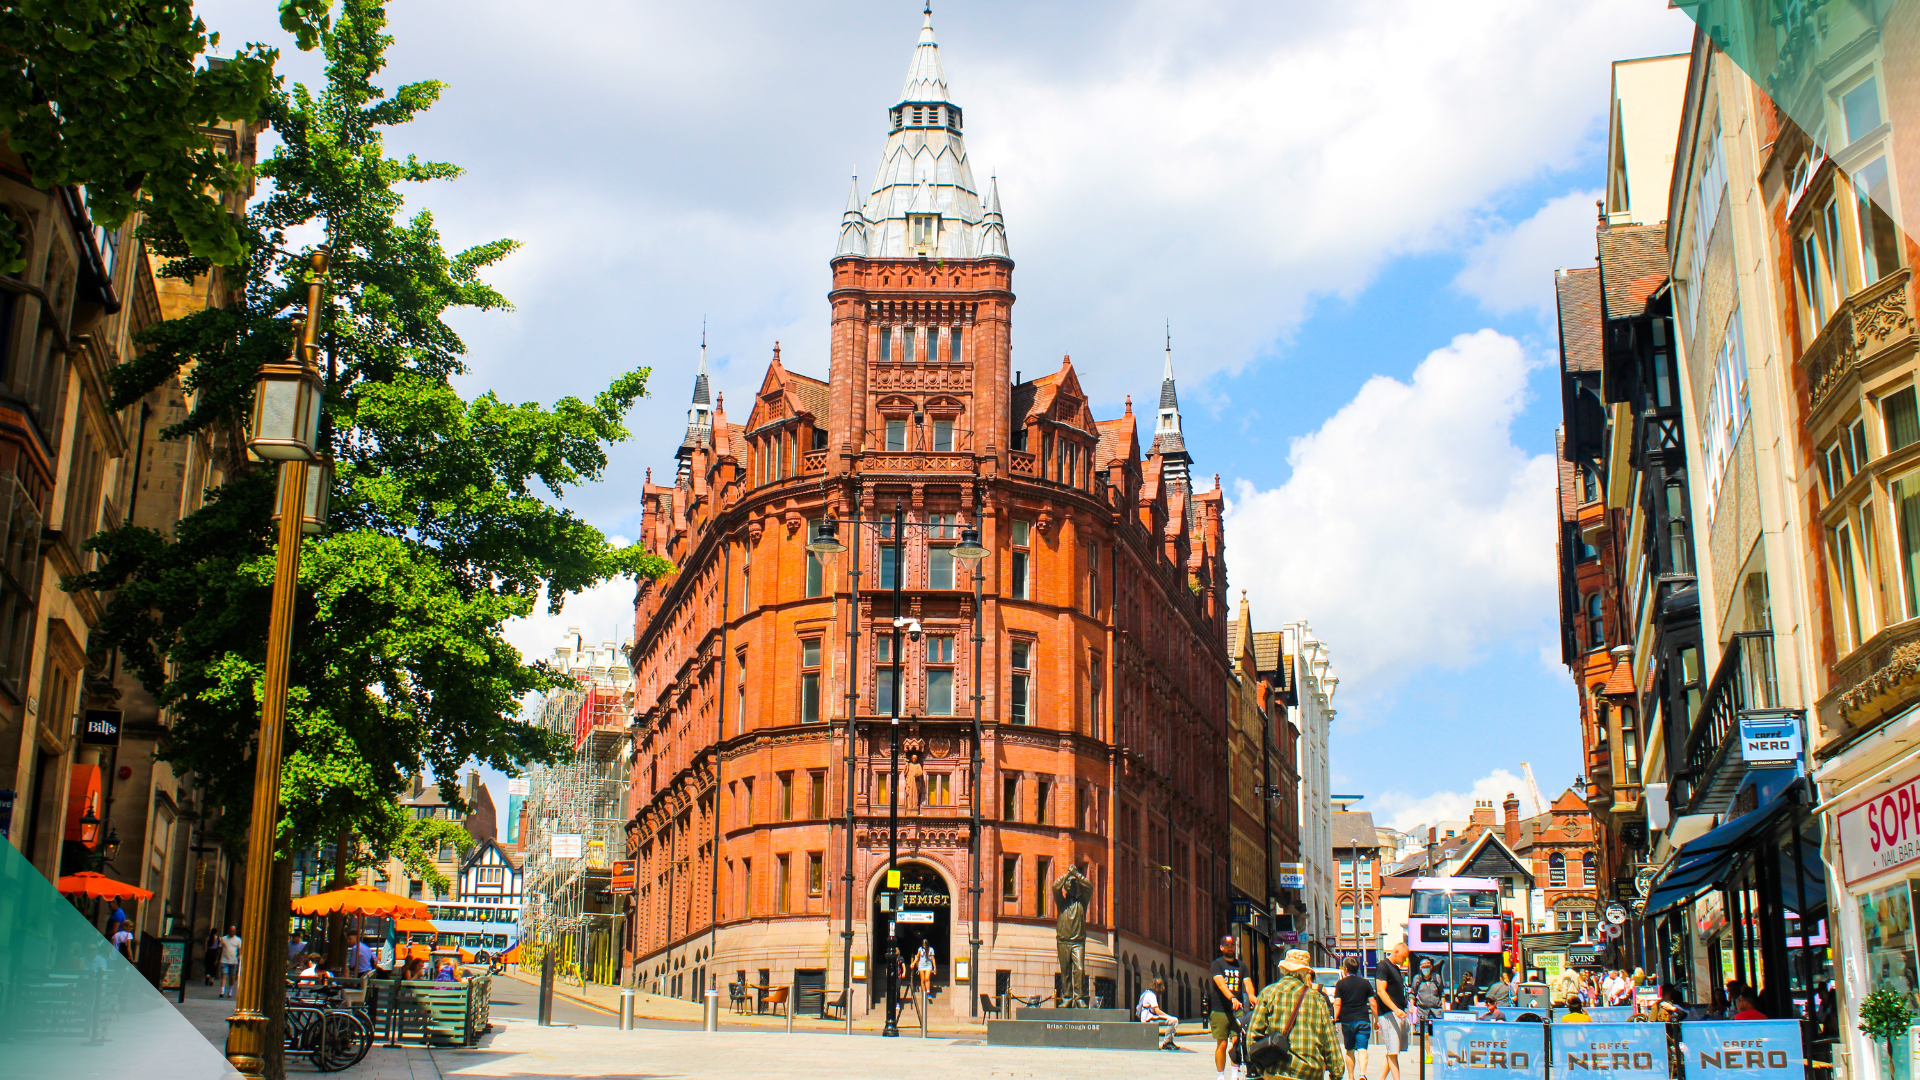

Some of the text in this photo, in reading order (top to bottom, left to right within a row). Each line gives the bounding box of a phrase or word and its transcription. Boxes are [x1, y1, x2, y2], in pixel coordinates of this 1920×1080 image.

[88, 720, 117, 735] Bill's
[1748, 741, 1790, 751] NERO
[1881, 849, 1898, 867] NAIL
[1898, 842, 1914, 861] BAR
[874, 895, 950, 904] AHEMIST
[1440, 927, 1482, 938] Caton 27
[1470, 1040, 1507, 1048] CAFFÈ
[1590, 1040, 1629, 1050] CAFFÈ
[1723, 1038, 1763, 1048] CAFFÈ
[1448, 1050, 1529, 1069] NERO
[1568, 1052, 1652, 1070] NERO
[1700, 1050, 1788, 1070] NERO
